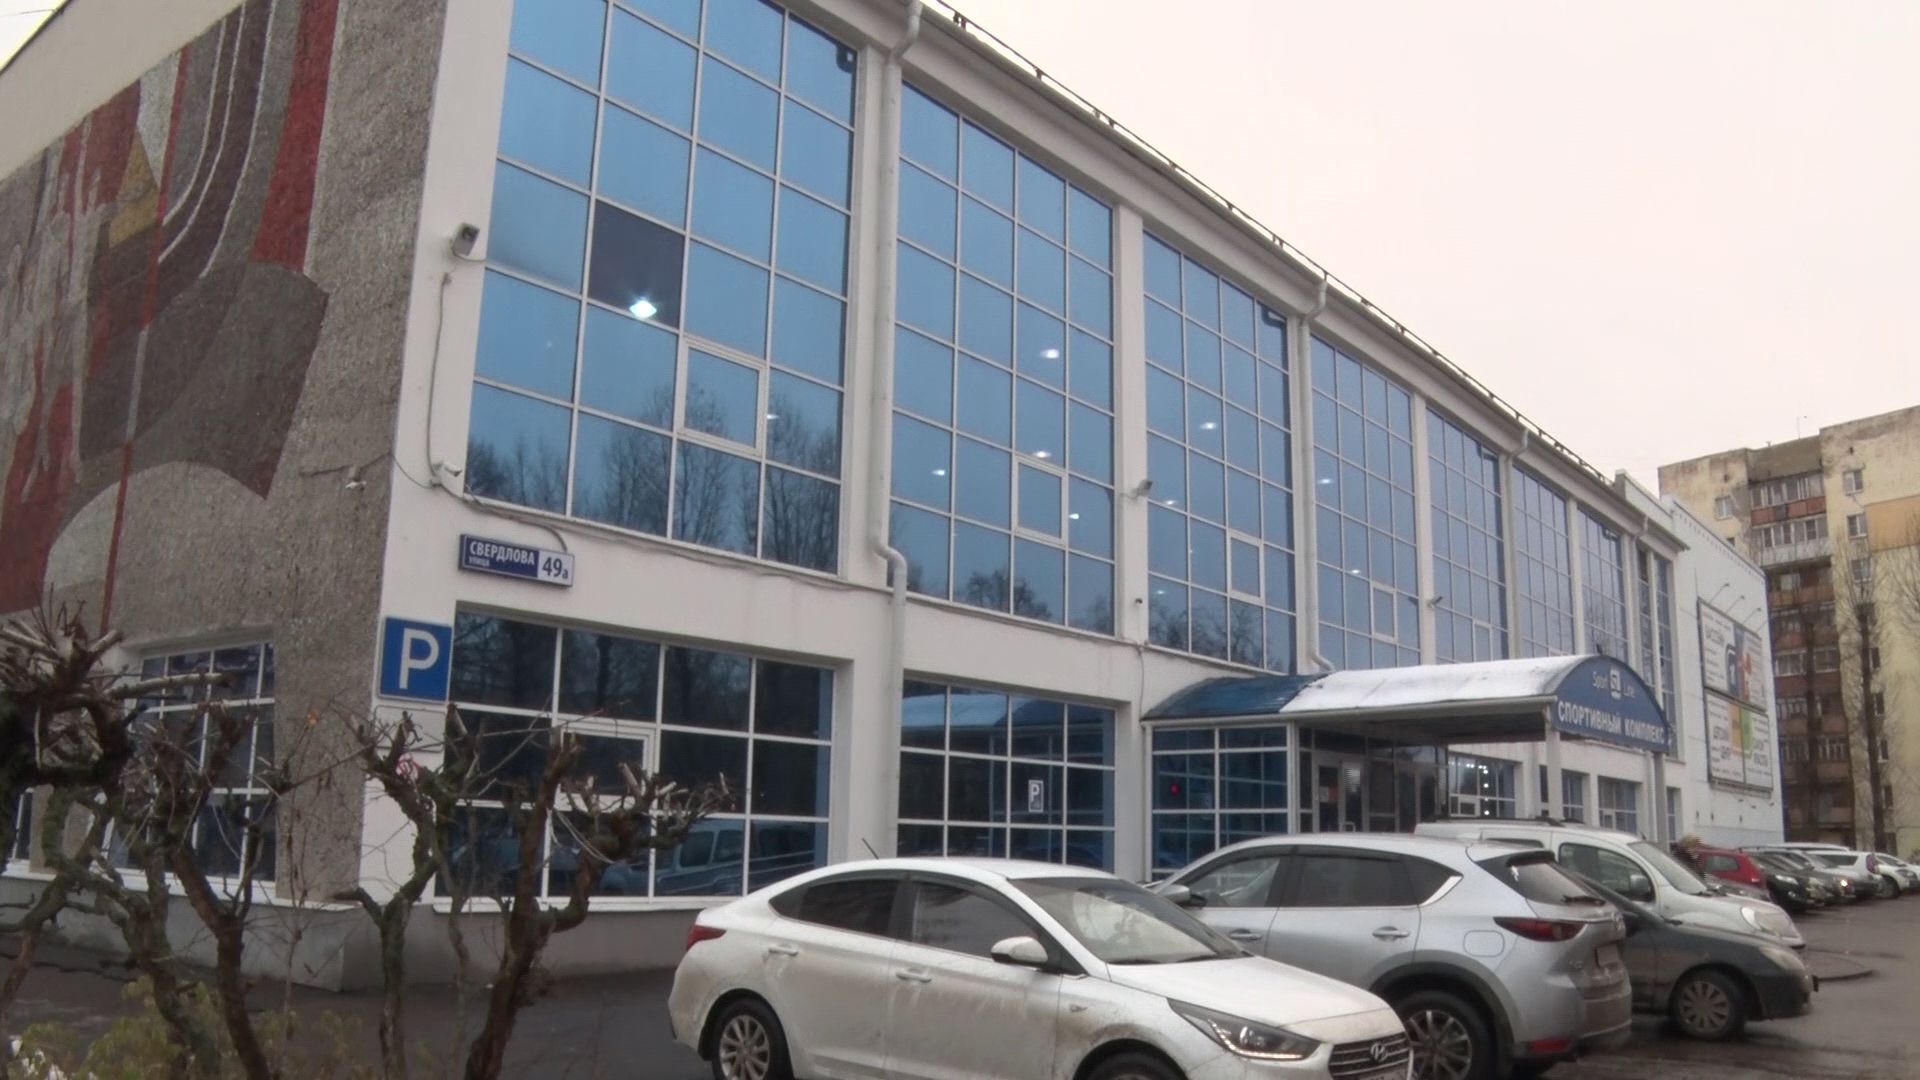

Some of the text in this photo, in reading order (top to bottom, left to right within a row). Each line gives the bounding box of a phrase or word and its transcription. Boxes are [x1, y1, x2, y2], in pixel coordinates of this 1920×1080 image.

[470, 541, 535, 565] СВЕРДЛОВА
[399, 627, 439, 690] P
[1558, 701, 1622, 734] СПОРТИВНЫЙ
